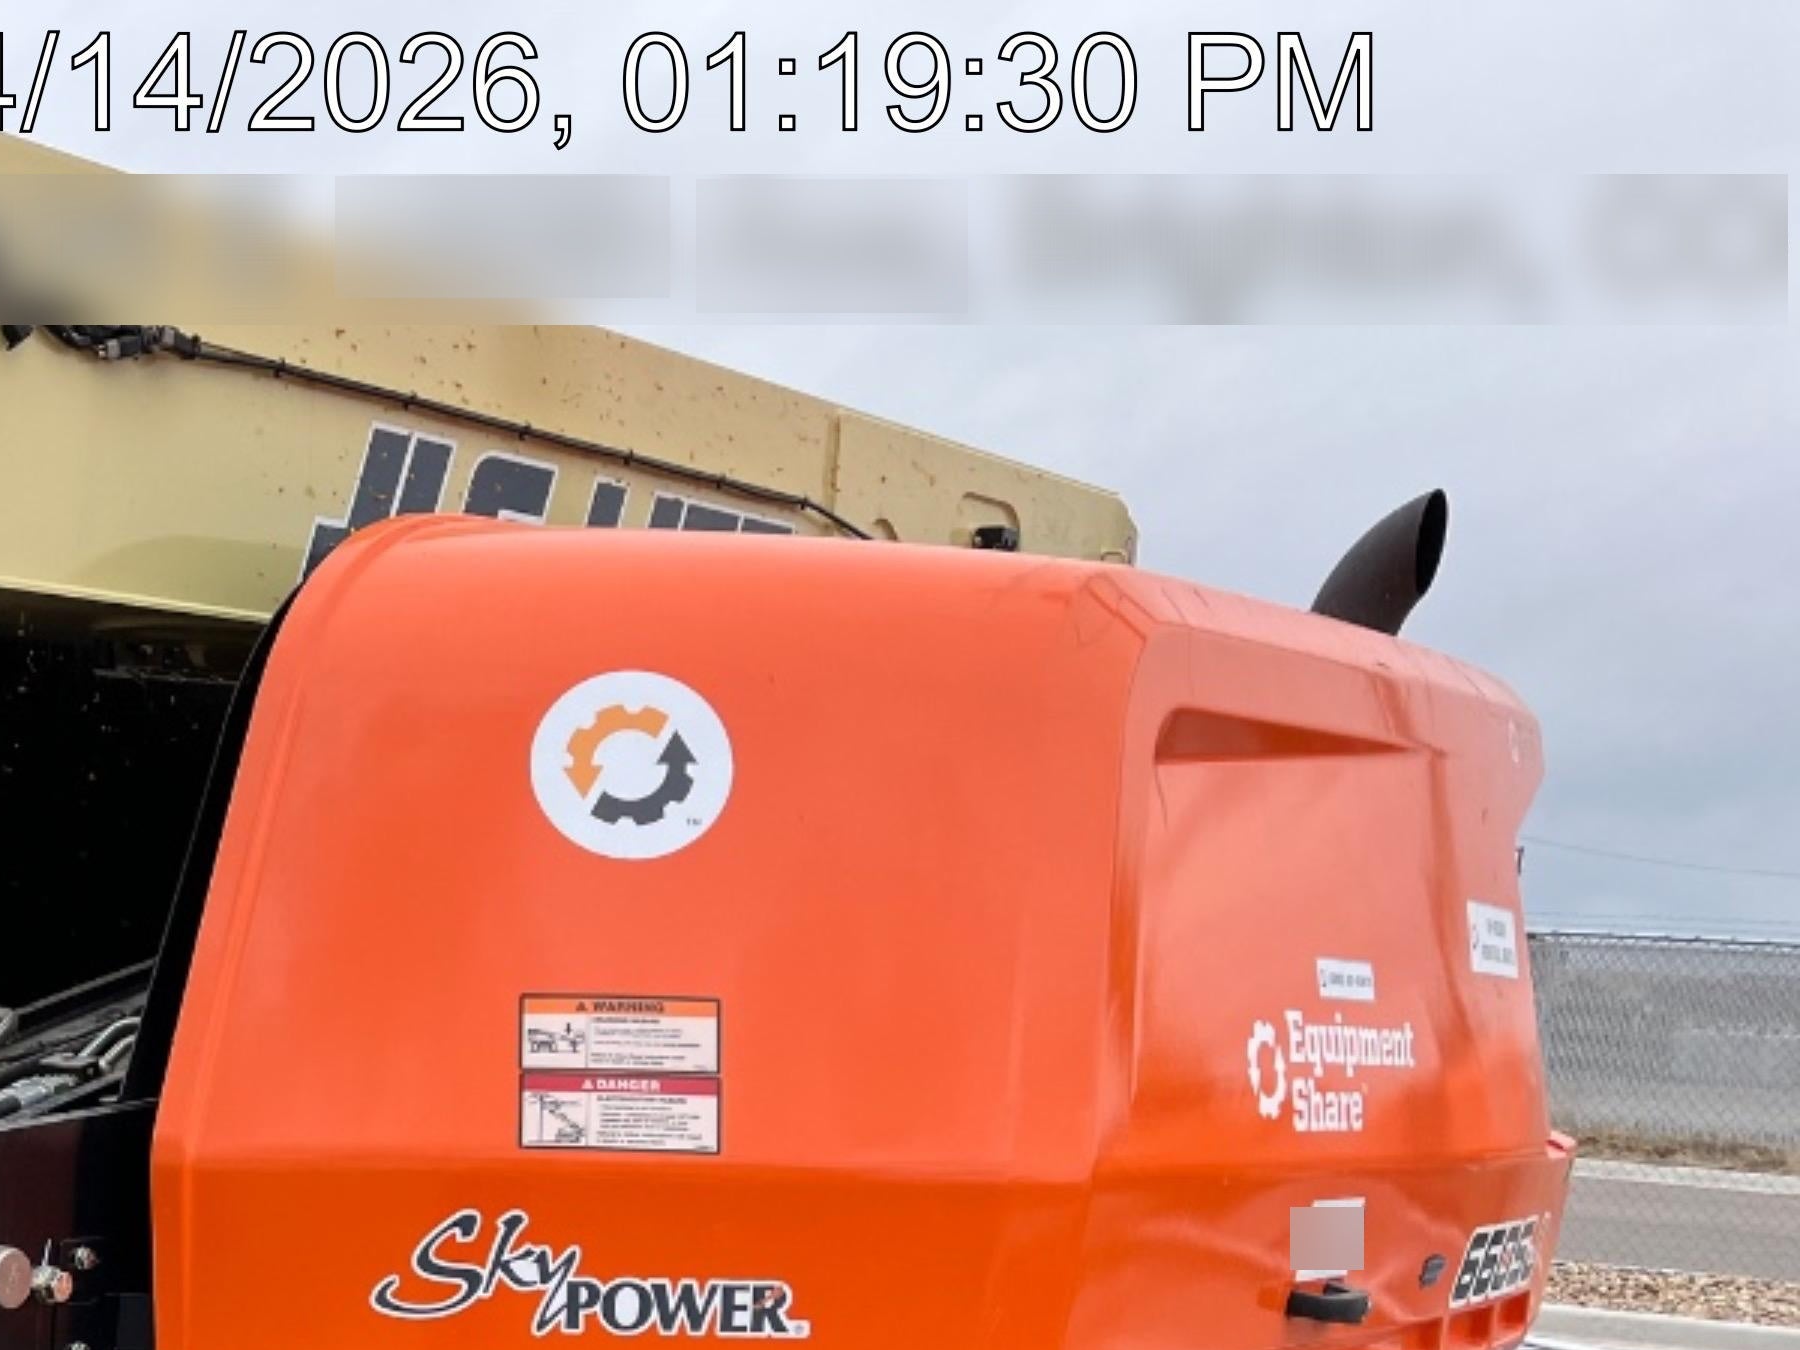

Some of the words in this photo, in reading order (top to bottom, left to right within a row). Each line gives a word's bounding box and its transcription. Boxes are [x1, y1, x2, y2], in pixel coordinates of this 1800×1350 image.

[593, 1000, 665, 1013] WARNING
[1284, 1010, 1416, 1078] Equipment
[596, 1079, 661, 1091] DANGER
[1292, 1079, 1364, 1132] Share
